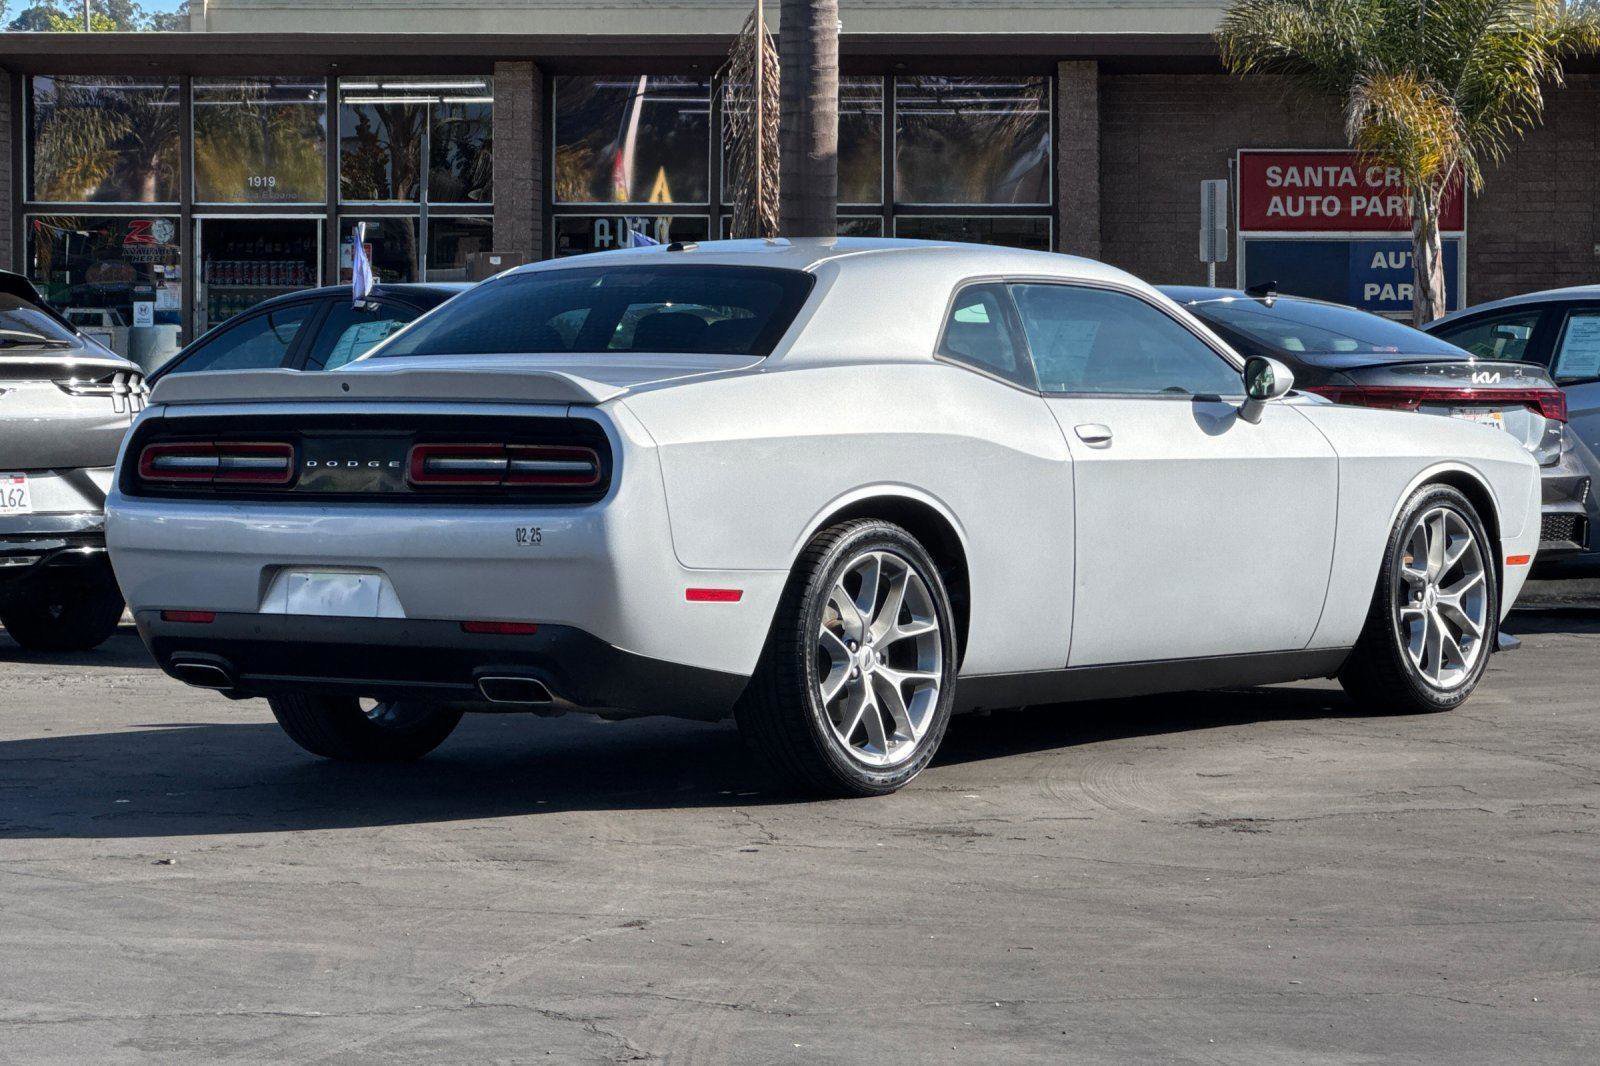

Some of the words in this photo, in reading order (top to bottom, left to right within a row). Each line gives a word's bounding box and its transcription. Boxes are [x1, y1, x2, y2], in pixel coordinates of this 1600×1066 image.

[247, 176, 276, 187] 1919
[1266, 166, 1357, 187] SANTA
[1365, 166, 1418, 188] CR
[1266, 196, 1341, 217] AUTO
[1364, 283, 1414, 301] PAR
[1471, 371, 1501, 384] KIA
[306, 460, 400, 468] DODGE
[515, 527, 527, 542] 02
[530, 527, 542, 542] 25
